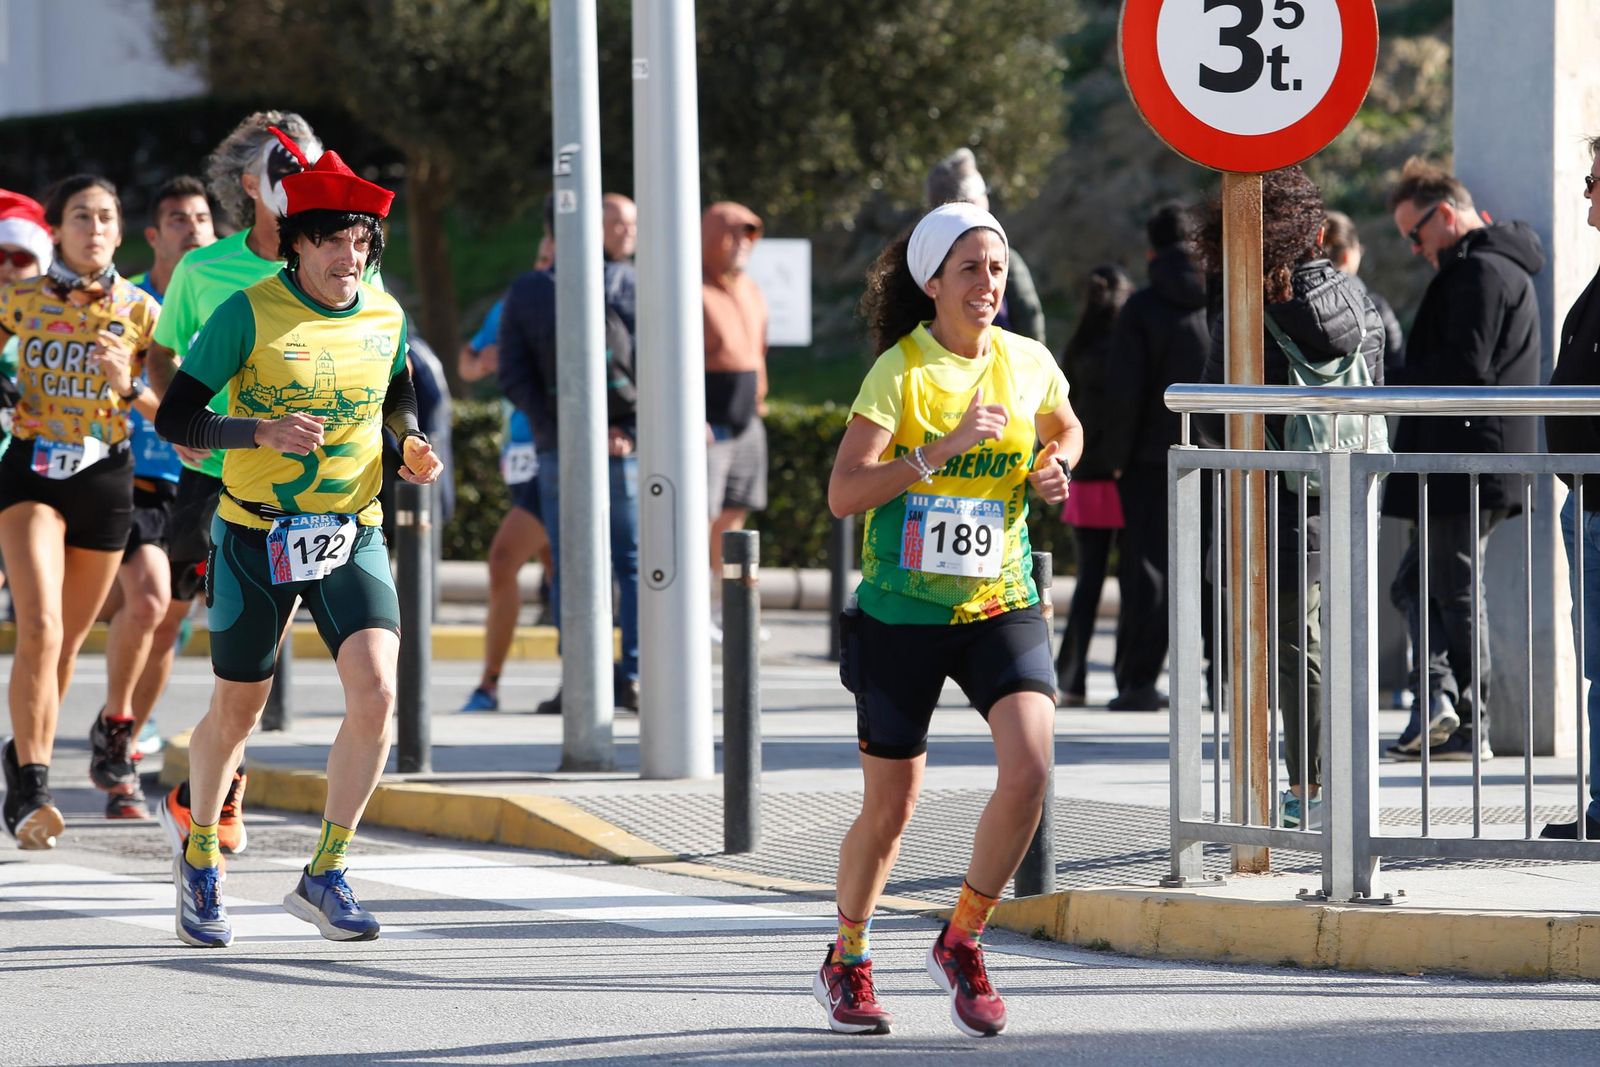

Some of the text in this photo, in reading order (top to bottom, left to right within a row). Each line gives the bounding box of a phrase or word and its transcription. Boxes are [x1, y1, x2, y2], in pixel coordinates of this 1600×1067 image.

[1199, 0, 1264, 93] 3
[25, 337, 100, 376] CORR
[42, 372, 113, 400] CALLA
[895, 444, 1023, 478] BREÑOS
[291, 514, 352, 526] CARRE
[908, 510, 923, 521] SAN
[912, 496, 1001, 512] III CARRERA
[293, 533, 346, 565] 122
[931, 521, 992, 557] 189
